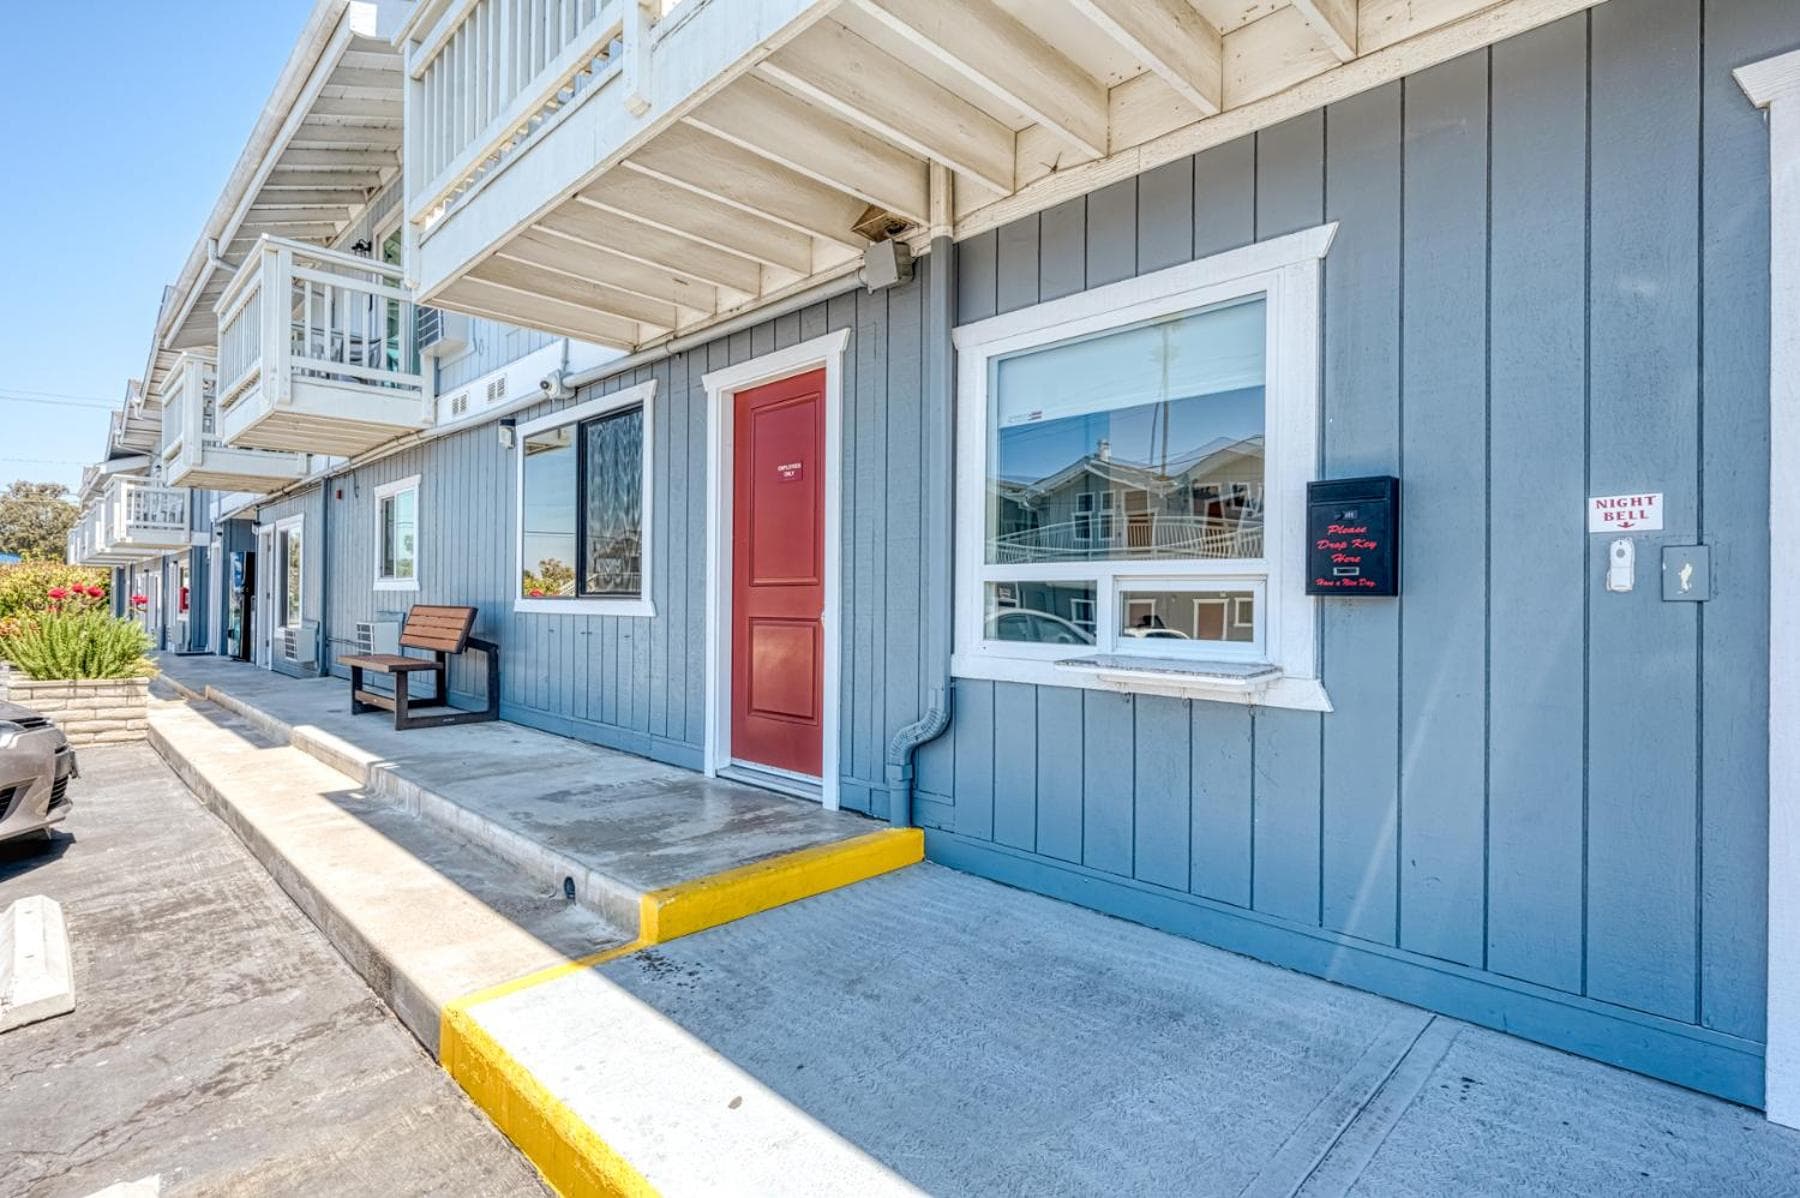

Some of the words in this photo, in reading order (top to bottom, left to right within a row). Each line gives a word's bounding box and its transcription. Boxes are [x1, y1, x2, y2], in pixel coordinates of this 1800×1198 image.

[1595, 496, 1656, 509] NIGHT
[1603, 510, 1649, 521] BELL
[1327, 525, 1367, 534] Please
[1316, 539, 1347, 550] Drop
[1351, 538, 1377, 550] Key
[1331, 553, 1361, 563] Here
